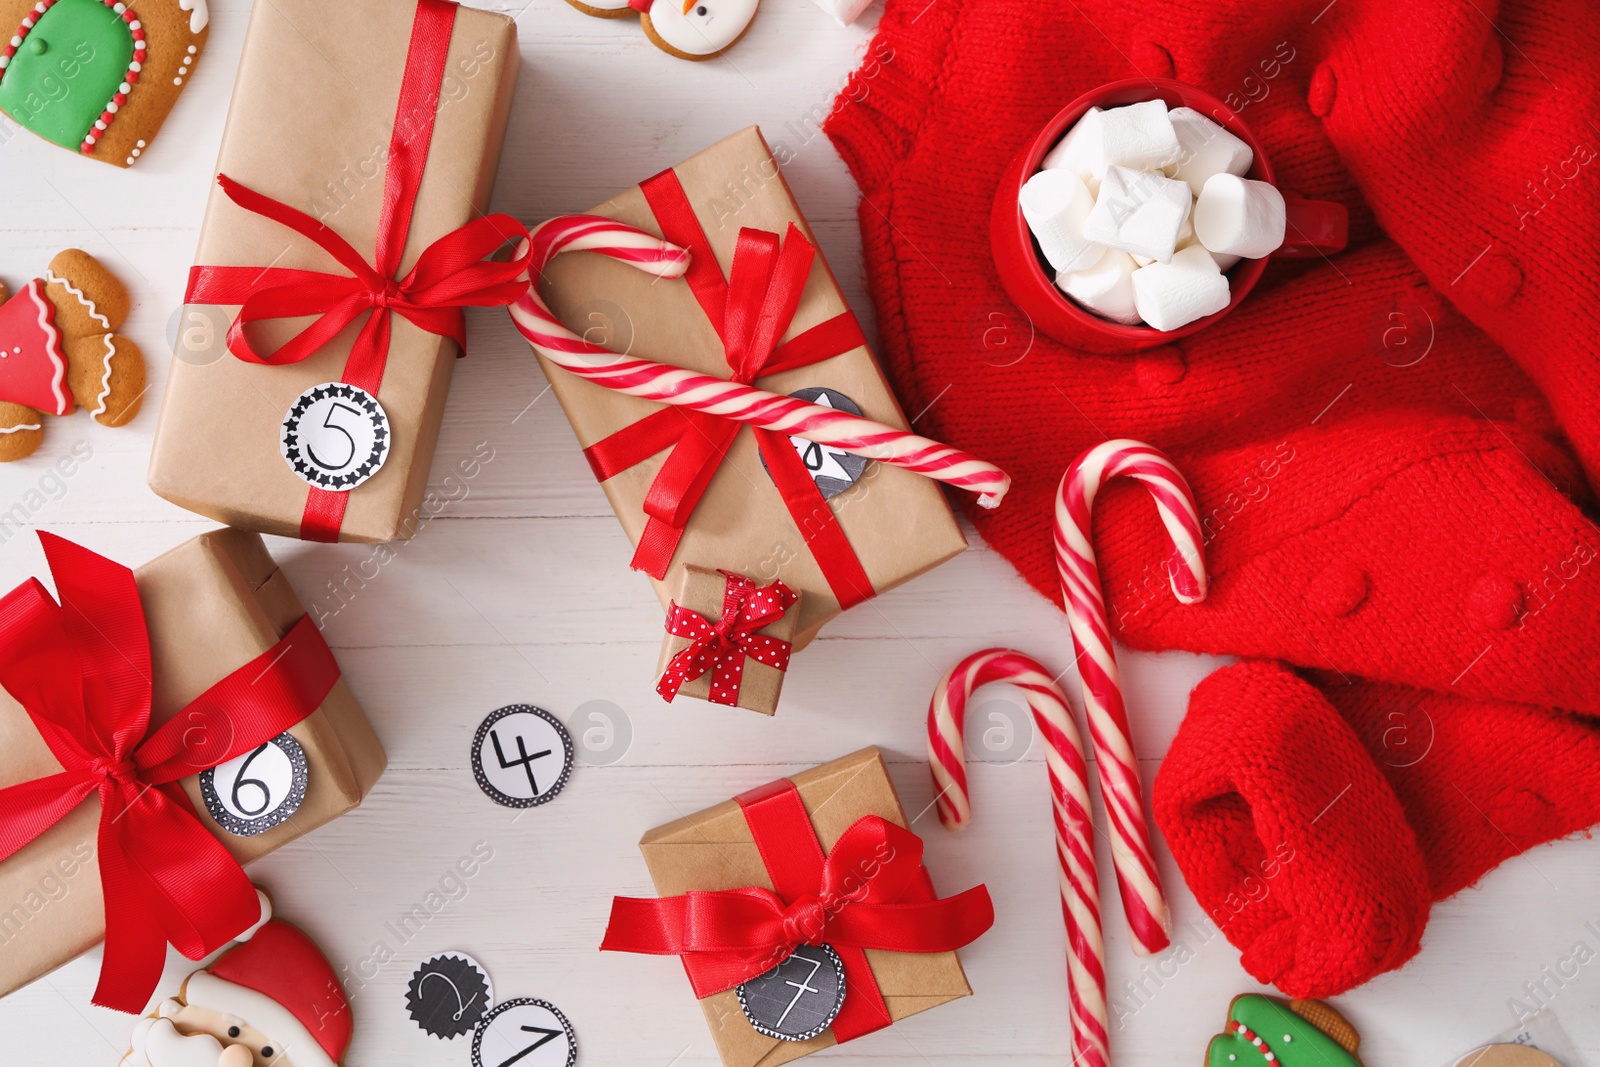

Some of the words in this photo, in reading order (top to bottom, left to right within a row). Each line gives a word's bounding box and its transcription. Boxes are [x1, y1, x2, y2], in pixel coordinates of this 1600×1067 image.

[307, 402, 361, 471] 5
[232, 742, 269, 816] 6
[490, 729, 552, 796] 4
[418, 971, 479, 1021] 2
[775, 953, 822, 1028] 7
